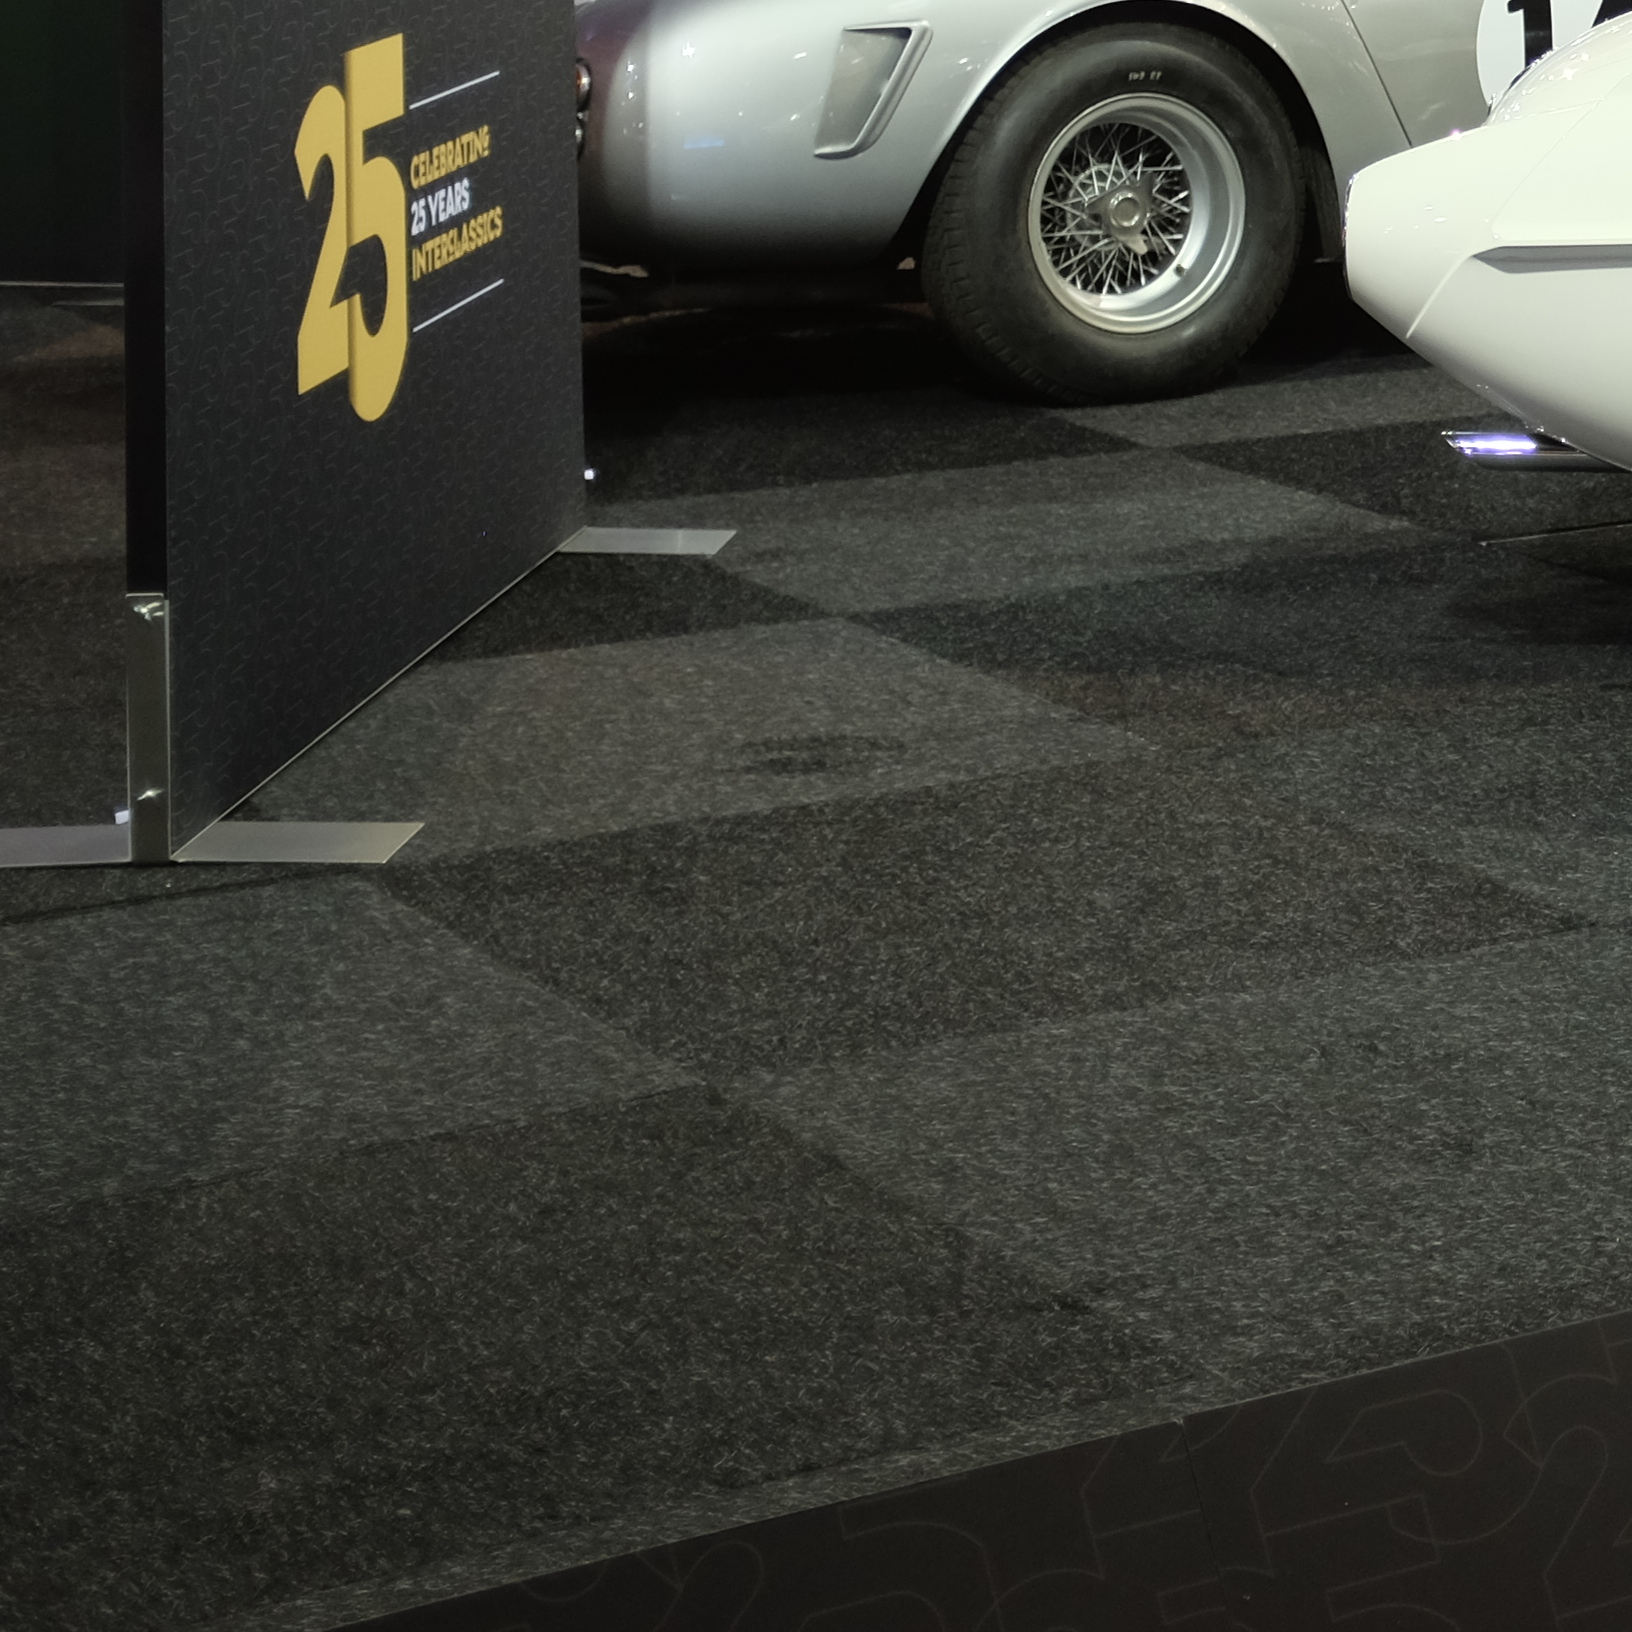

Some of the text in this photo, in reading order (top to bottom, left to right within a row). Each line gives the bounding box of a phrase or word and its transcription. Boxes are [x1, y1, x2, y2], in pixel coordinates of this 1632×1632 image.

[410, 125, 490, 190] CELEBRATING
[294, 33, 409, 422] 25
[411, 179, 470, 237] 25 YEARS
[411, 206, 503, 282] INTERCLASSICS
